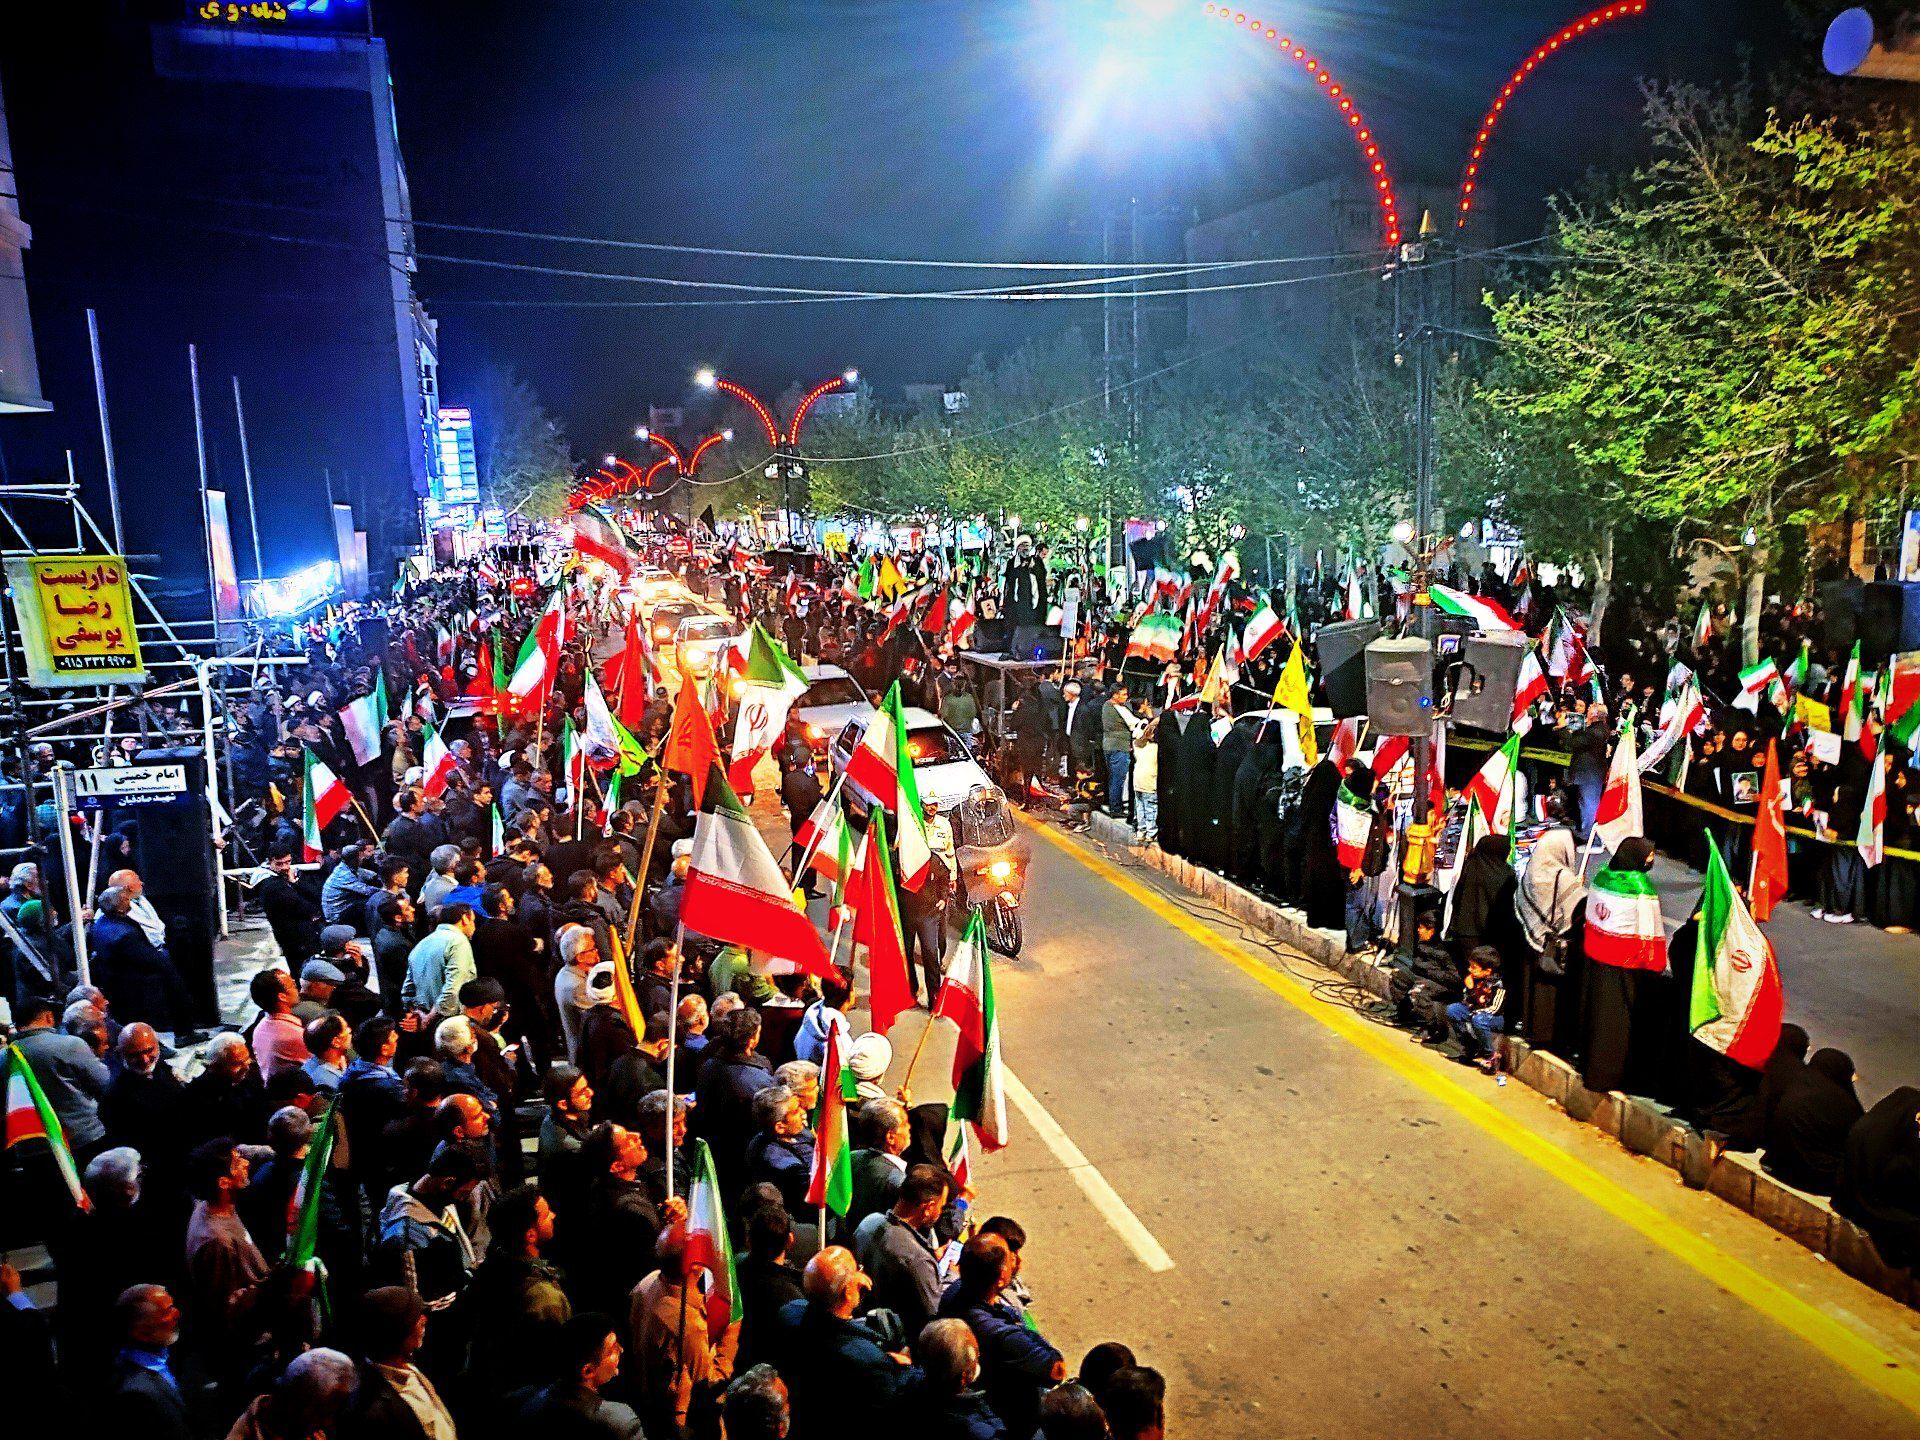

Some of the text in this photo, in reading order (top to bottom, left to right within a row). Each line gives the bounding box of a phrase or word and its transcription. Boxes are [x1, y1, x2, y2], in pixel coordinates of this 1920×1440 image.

[41, 565, 119, 590] داربست
[54, 594, 112, 619] رضا
[57, 621, 124, 650] یوسفی
[113, 769, 152, 785] خمینی
[156, 768, 179, 782] امام
